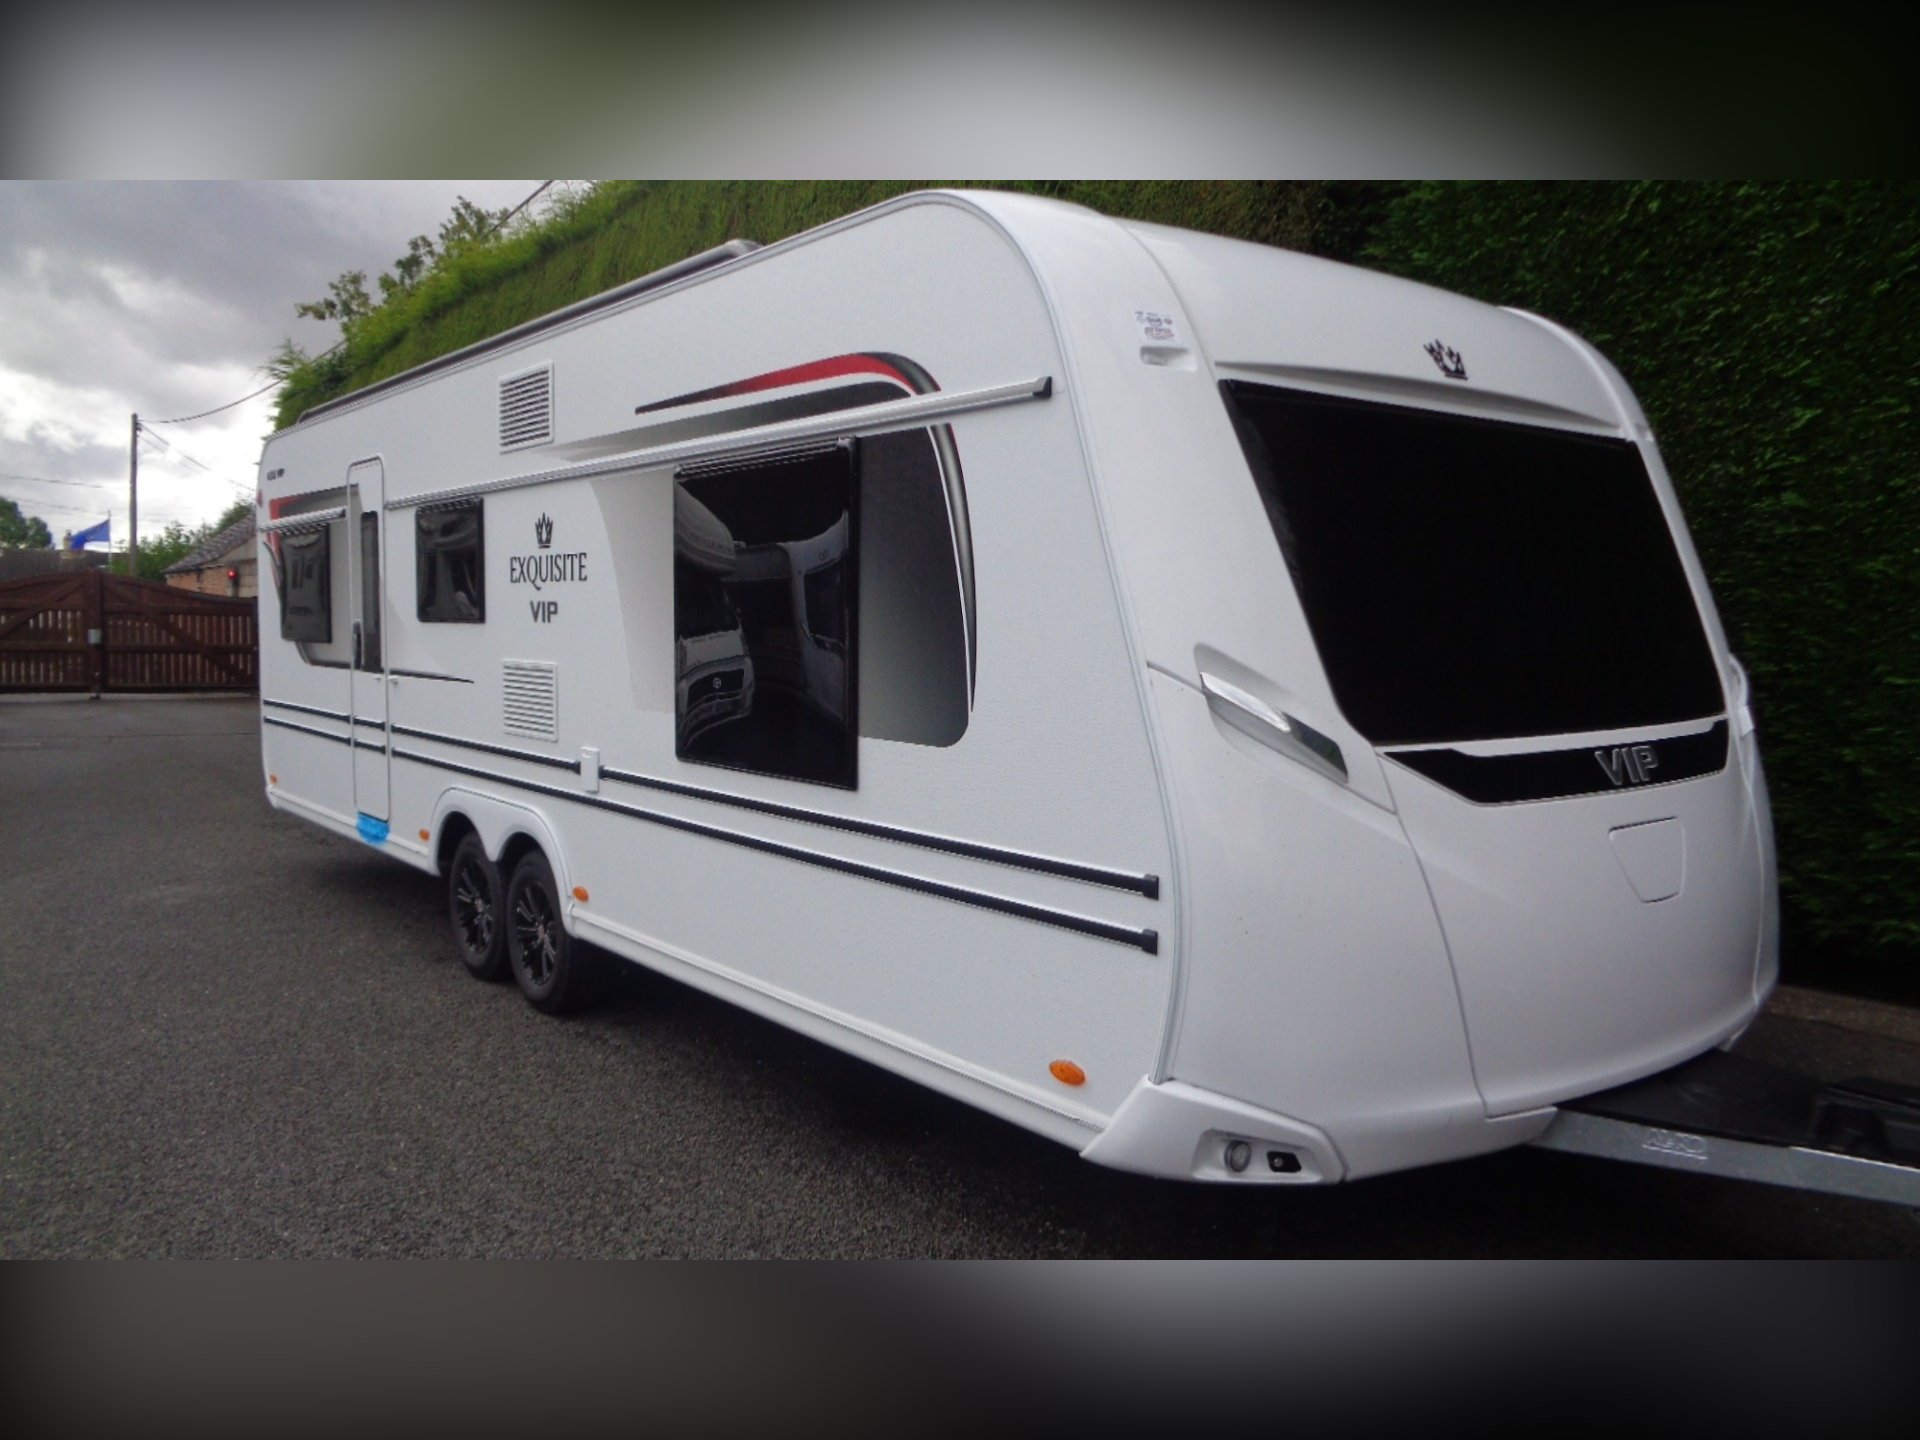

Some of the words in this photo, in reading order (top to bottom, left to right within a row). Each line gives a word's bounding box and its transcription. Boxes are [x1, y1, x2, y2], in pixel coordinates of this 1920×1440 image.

[510, 552, 588, 591] EXQUISITE
[529, 600, 558, 623] VIP
[1594, 745, 1658, 786] VIP
